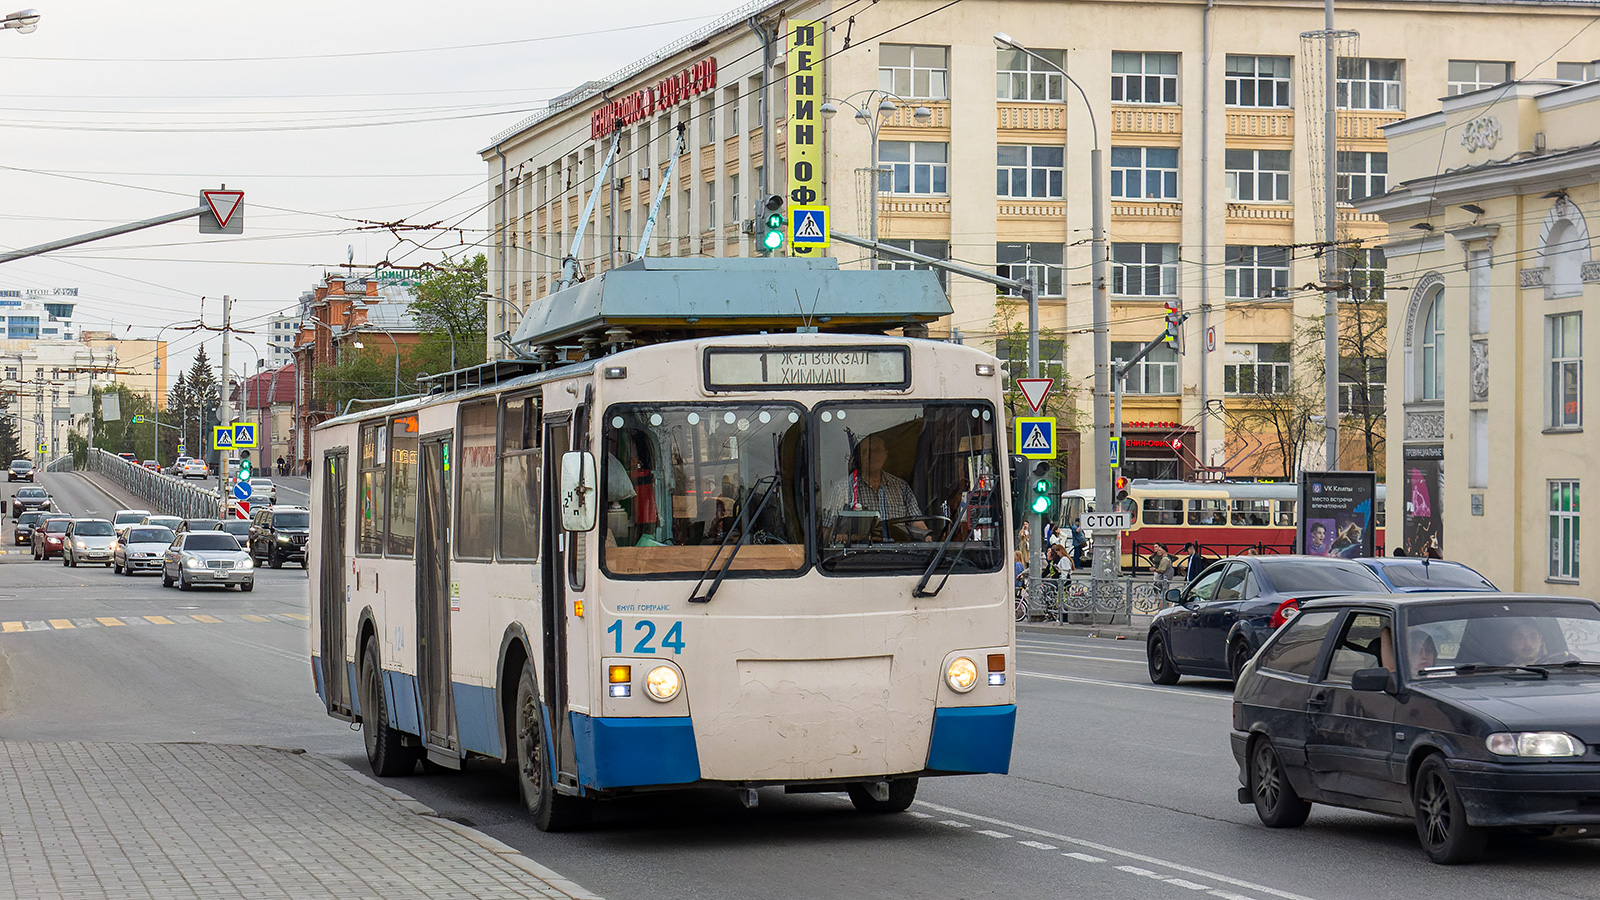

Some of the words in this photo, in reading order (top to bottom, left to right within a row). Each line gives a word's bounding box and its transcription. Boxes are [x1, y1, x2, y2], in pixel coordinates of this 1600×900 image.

[759, 354, 768, 382] 1
[781, 367, 846, 384] ХИММАШ
[1087, 515, 1124, 527] СТОП
[606, 618, 686, 655] 124
